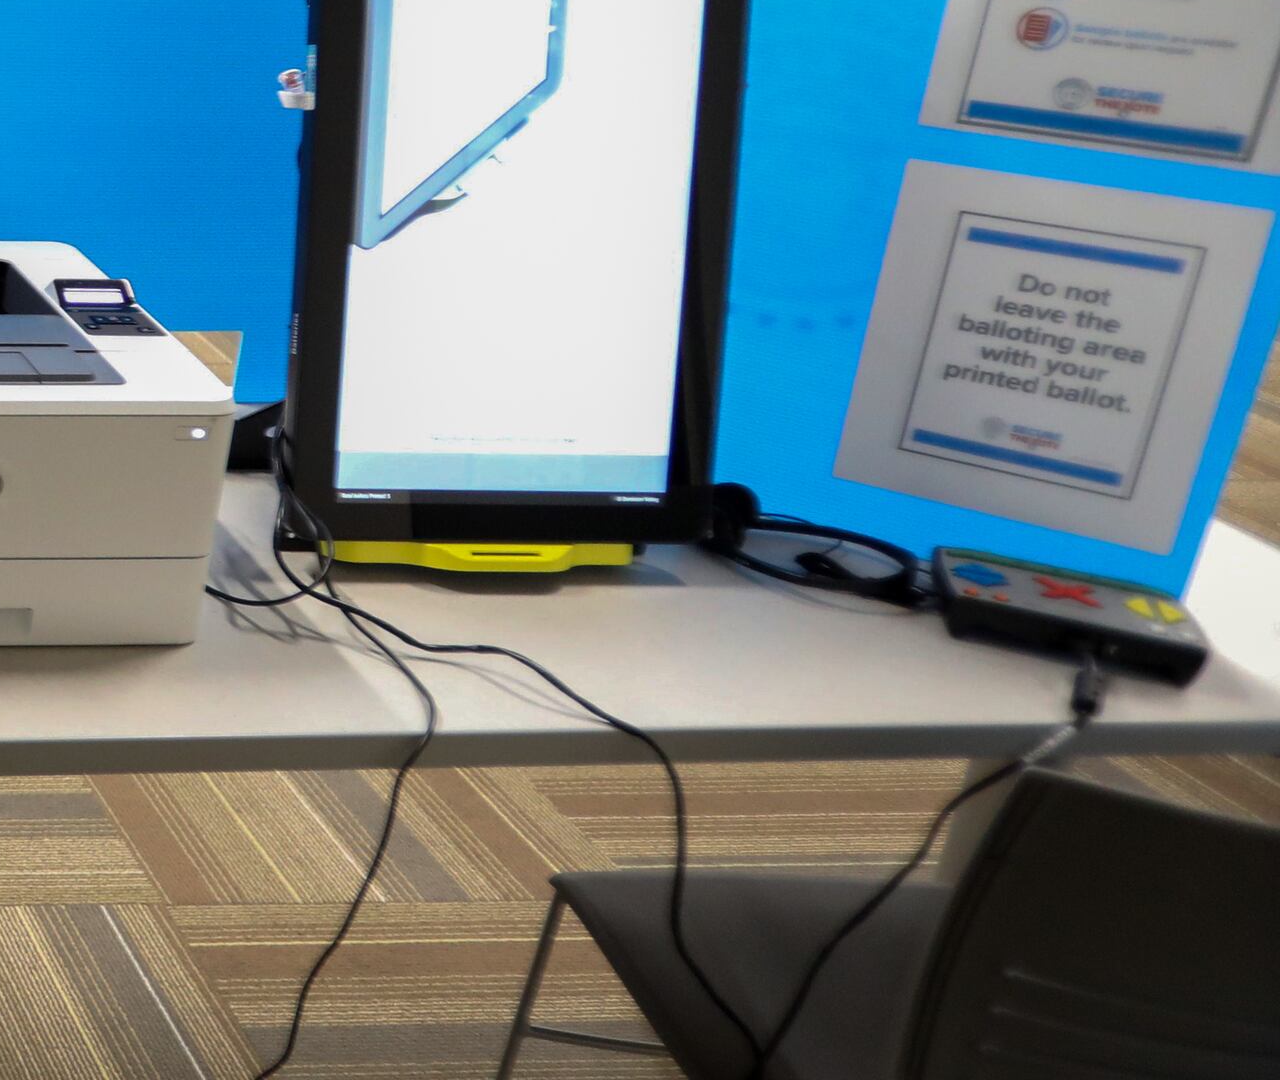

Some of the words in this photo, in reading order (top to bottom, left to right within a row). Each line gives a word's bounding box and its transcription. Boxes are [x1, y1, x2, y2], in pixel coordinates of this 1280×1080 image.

[1018, 273, 1056, 296] Do
[1064, 284, 1112, 307] not
[994, 295, 1068, 324] leave
[1075, 309, 1121, 334] the
[957, 313, 1076, 355] balloting
[1082, 339, 1148, 365] area
[980, 346, 1038, 370] with
[1044, 357, 1111, 383] your
[942, 362, 1040, 394] printed
[1046, 380, 1131, 414] ballot.
